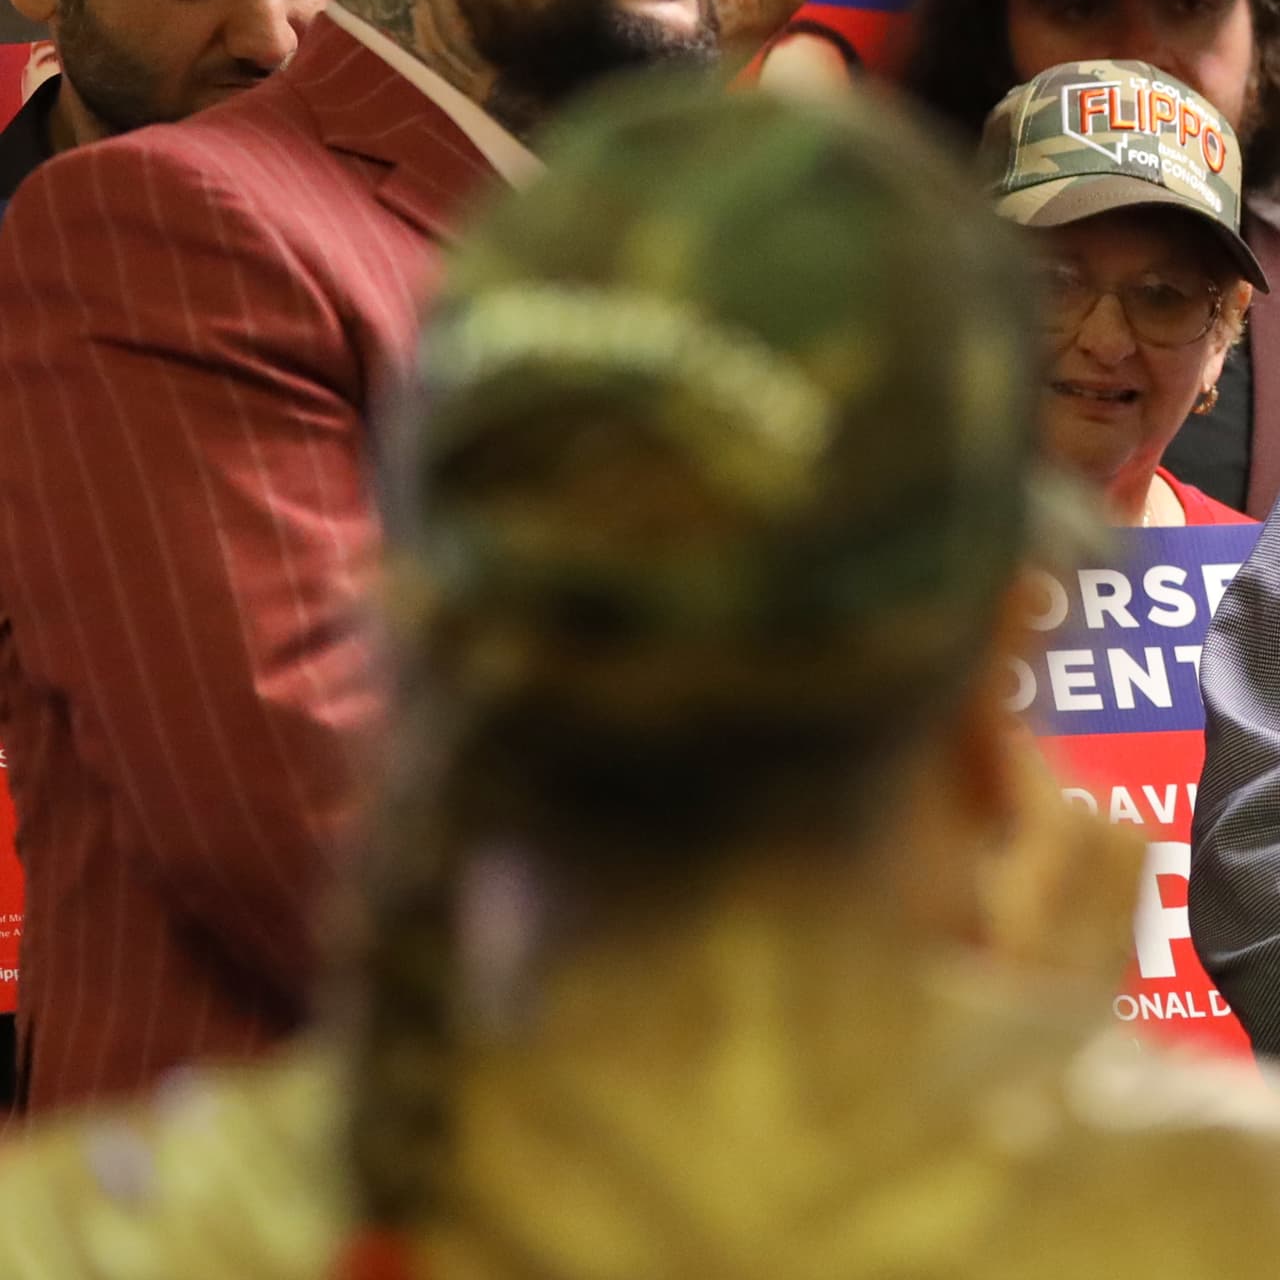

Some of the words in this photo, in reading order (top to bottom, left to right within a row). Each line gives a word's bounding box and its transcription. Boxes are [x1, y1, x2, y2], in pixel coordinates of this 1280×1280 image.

[1128, 76, 1150, 90] LT
[1078, 86, 1228, 175] FLIPPO
[1127, 148, 1160, 170] FOR
